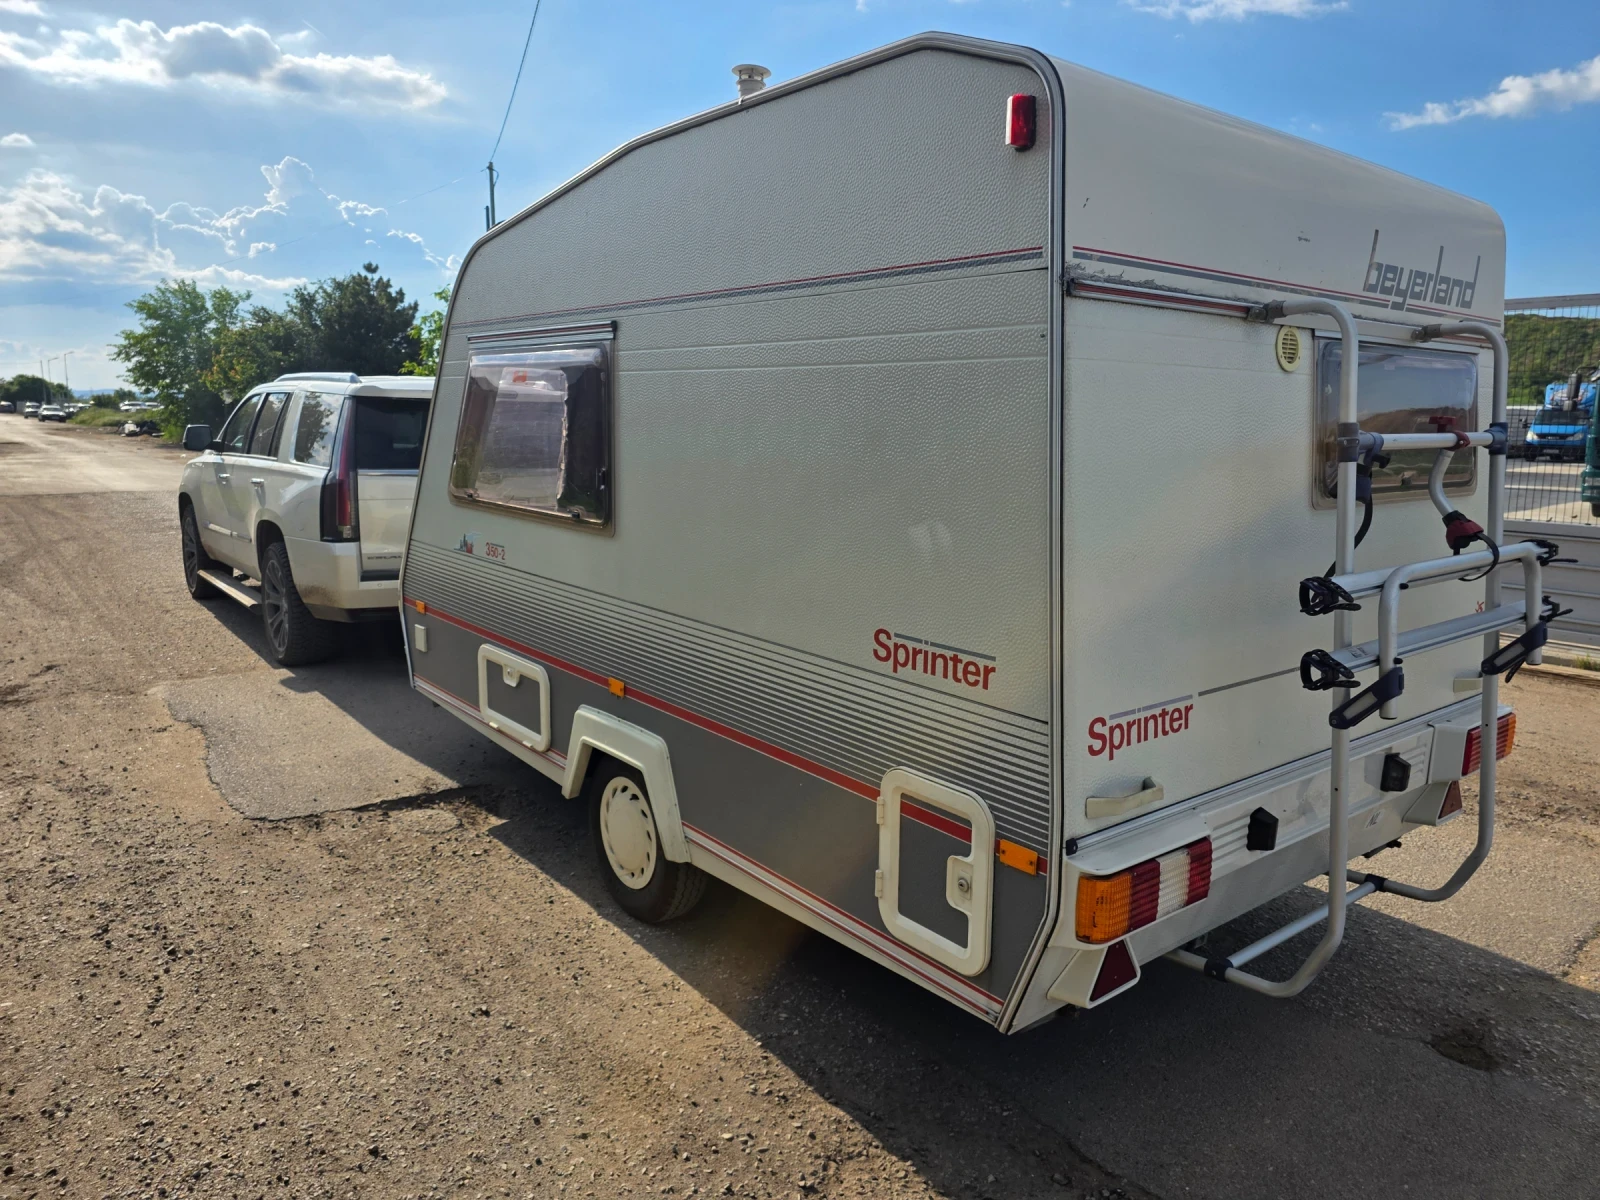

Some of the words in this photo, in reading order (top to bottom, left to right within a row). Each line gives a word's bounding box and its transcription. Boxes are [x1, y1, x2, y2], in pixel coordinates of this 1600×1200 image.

[1363, 229, 1481, 311] beyerland
[485, 542, 506, 560] 350-2
[872, 628, 997, 690] Sprinter
[1087, 703, 1194, 761] Sprinter
